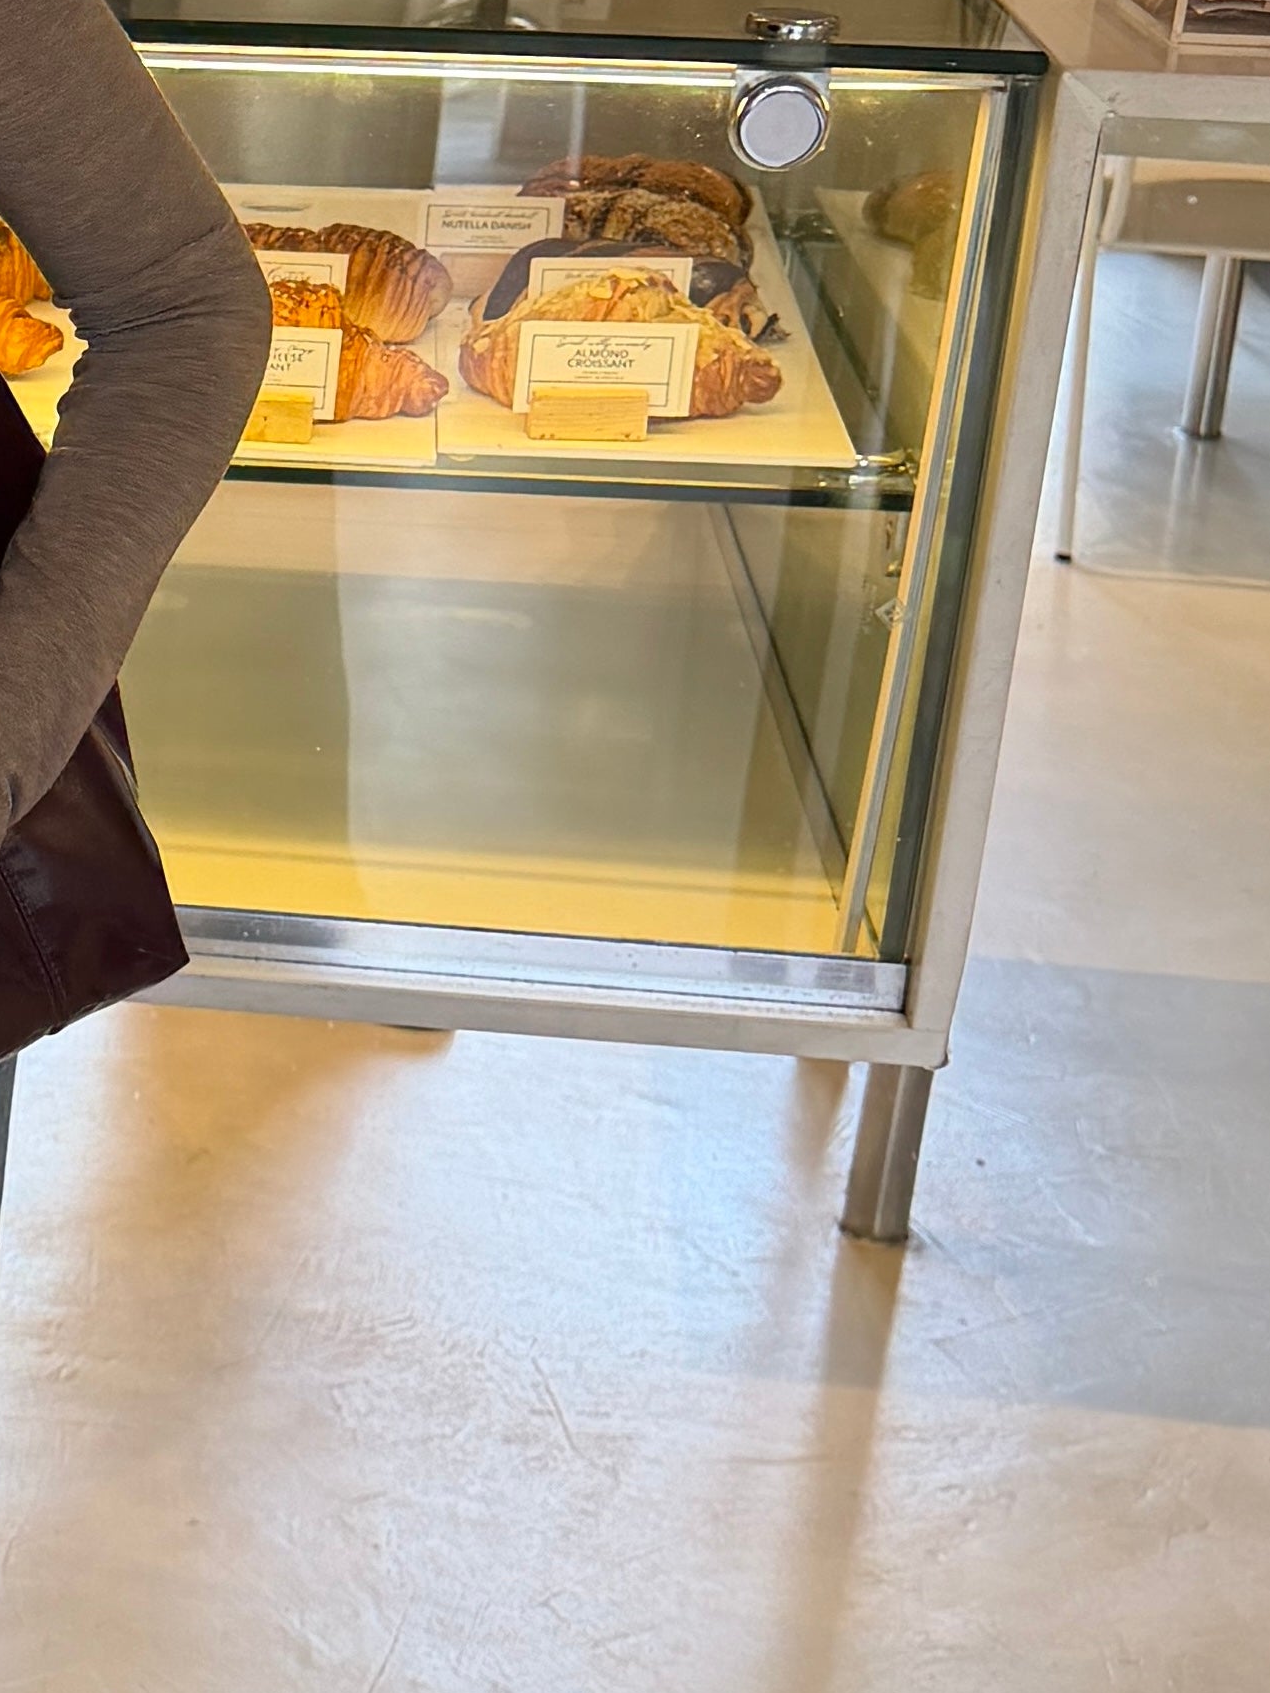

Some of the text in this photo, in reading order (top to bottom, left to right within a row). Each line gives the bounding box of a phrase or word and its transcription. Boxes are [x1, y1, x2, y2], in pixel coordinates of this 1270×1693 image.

[441, 219, 532, 231] NUTELLA DANISH
[574, 349, 630, 358] ALMOND
[567, 358, 636, 369] CROISSANT
